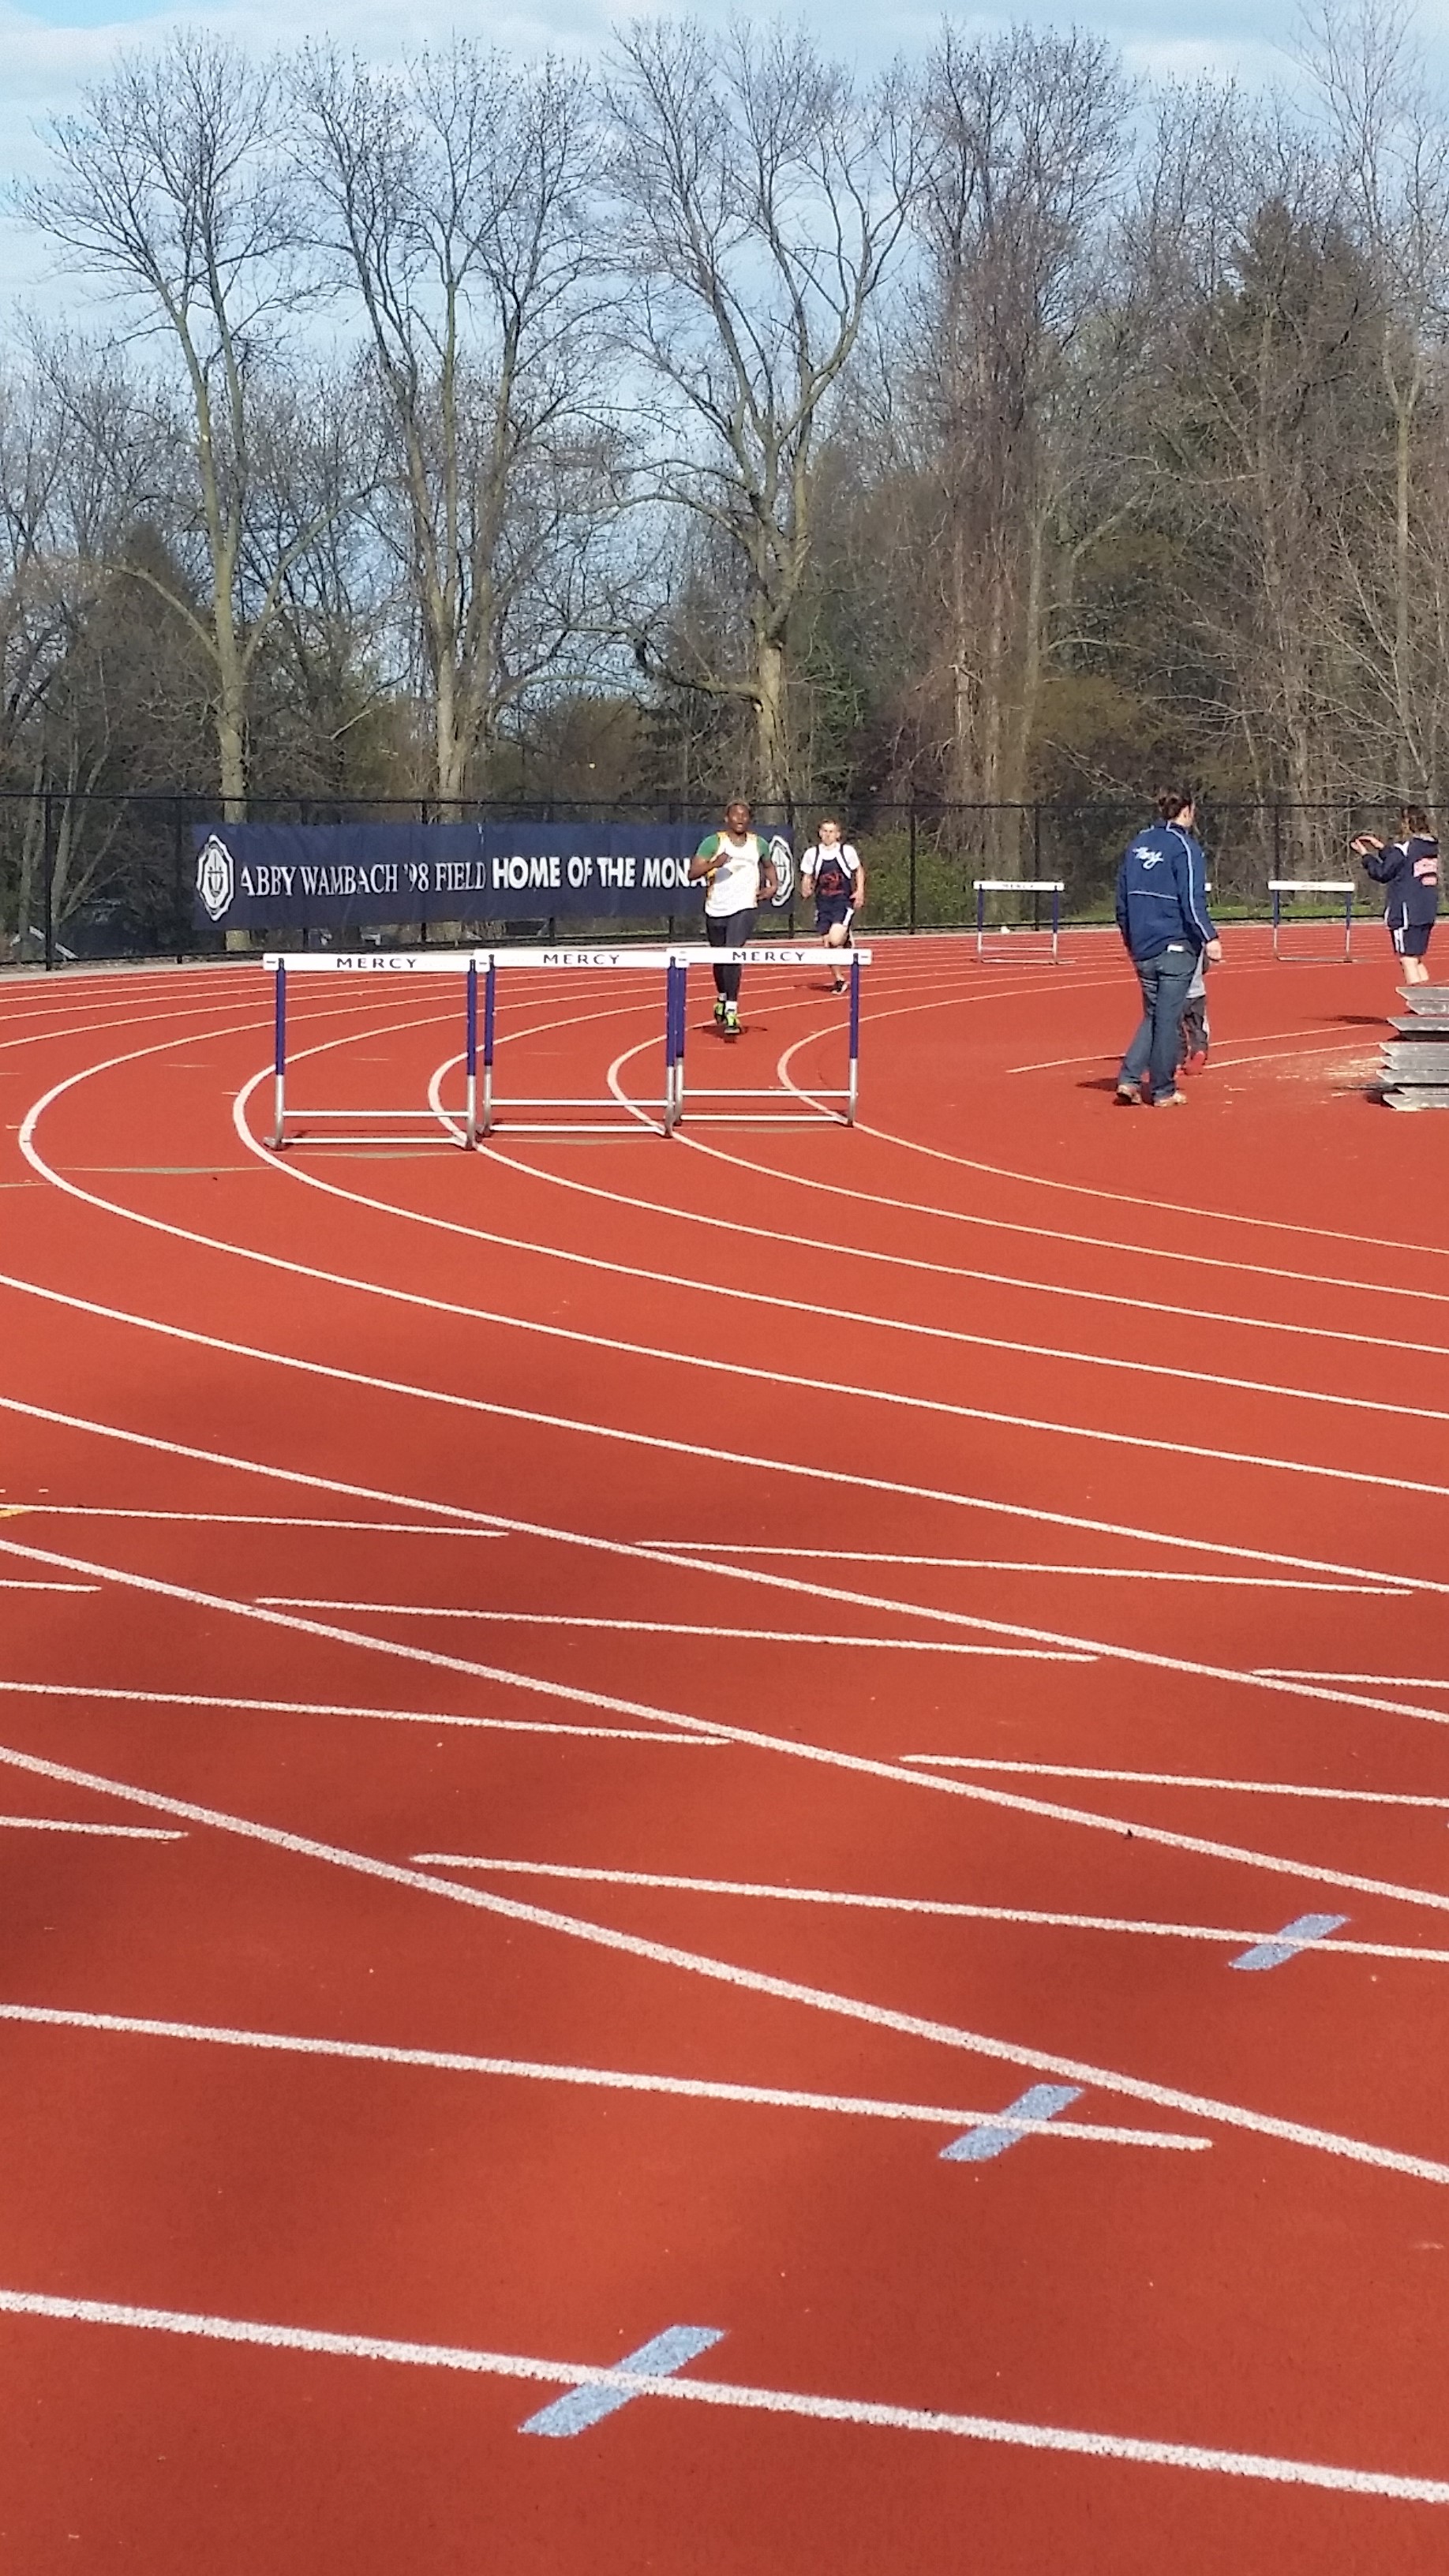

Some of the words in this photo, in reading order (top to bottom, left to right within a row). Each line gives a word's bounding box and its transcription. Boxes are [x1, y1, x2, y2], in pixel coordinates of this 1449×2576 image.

[492, 856, 561, 889] HOME
[567, 856, 593, 888] OF
[596, 856, 636, 888] THE
[240, 866, 297, 897] ABBY
[301, 863, 399, 897] WAMBACH
[403, 863, 429, 893] '98
[435, 861, 486, 892] FIELD
[543, 953, 620, 965] MERCY
[732, 951, 805, 961] MERCY
[337, 957, 417, 969] MERCY
